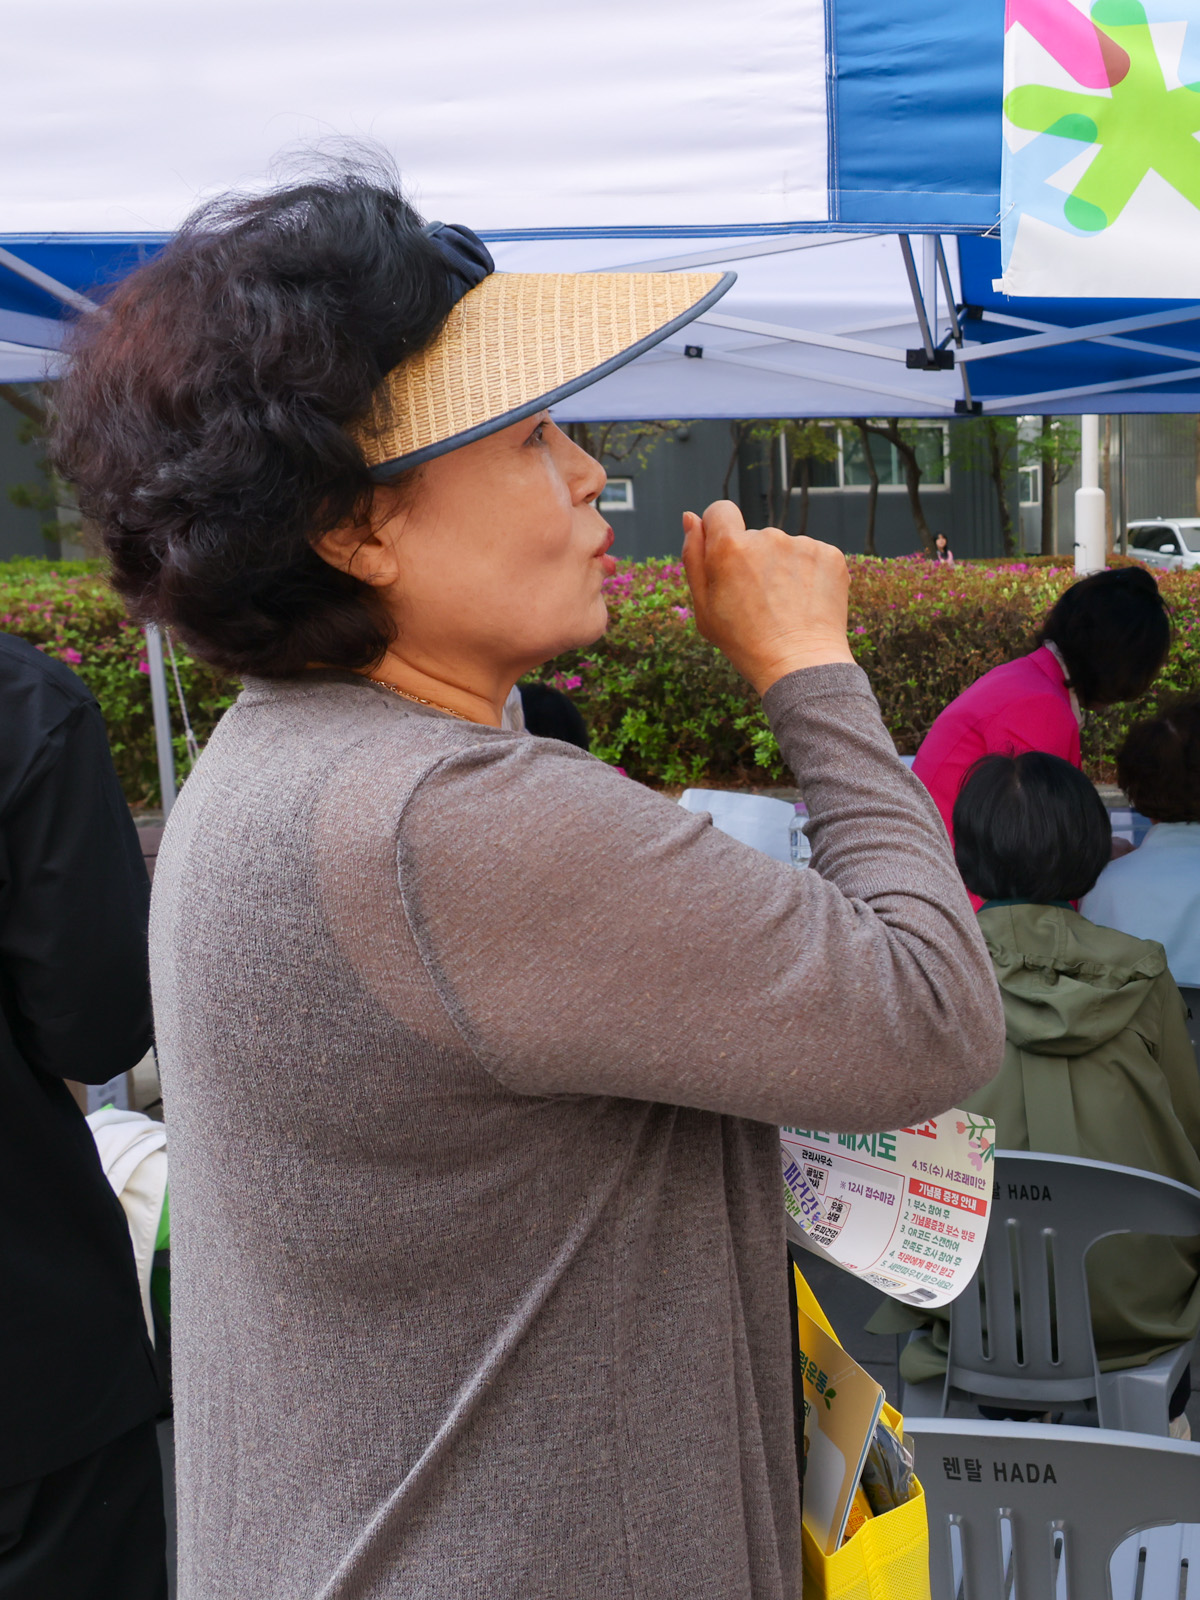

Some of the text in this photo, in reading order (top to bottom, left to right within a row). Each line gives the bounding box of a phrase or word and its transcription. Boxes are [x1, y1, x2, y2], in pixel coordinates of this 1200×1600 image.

[801, 1150, 833, 1167] 관리사무소
[912, 1160, 987, 1191] 4.15.(수) 서초래미안
[848, 1181, 864, 1196] 12시
[865, 1186, 896, 1206] 접수마감
[918, 1182, 977, 1211] 기념품 증정 안내
[1007, 1183, 1053, 1201] HADA
[913, 1200, 927, 1212] 부스
[928, 1203, 942, 1216] 참여
[943, 1209, 951, 1219] 후
[814, 1224, 839, 1238] 두피건강
[907, 1226, 931, 1243] QR코드
[932, 1232, 960, 1252] 스캔하여
[911, 1213, 945, 1233] 기념품증정
[946, 1224, 959, 1237] 부스
[961, 1230, 976, 1242] 방문
[897, 1251, 925, 1268] 직원에게
[925, 1258, 940, 1273] 확인
[940, 1265, 956, 1279] 받고
[902, 1239, 963, 1267] 만족도 조사 참여 후
[923, 1271, 954, 1291] 받으세요!
[942, 1457, 1058, 1484] 렌탈 HADA
